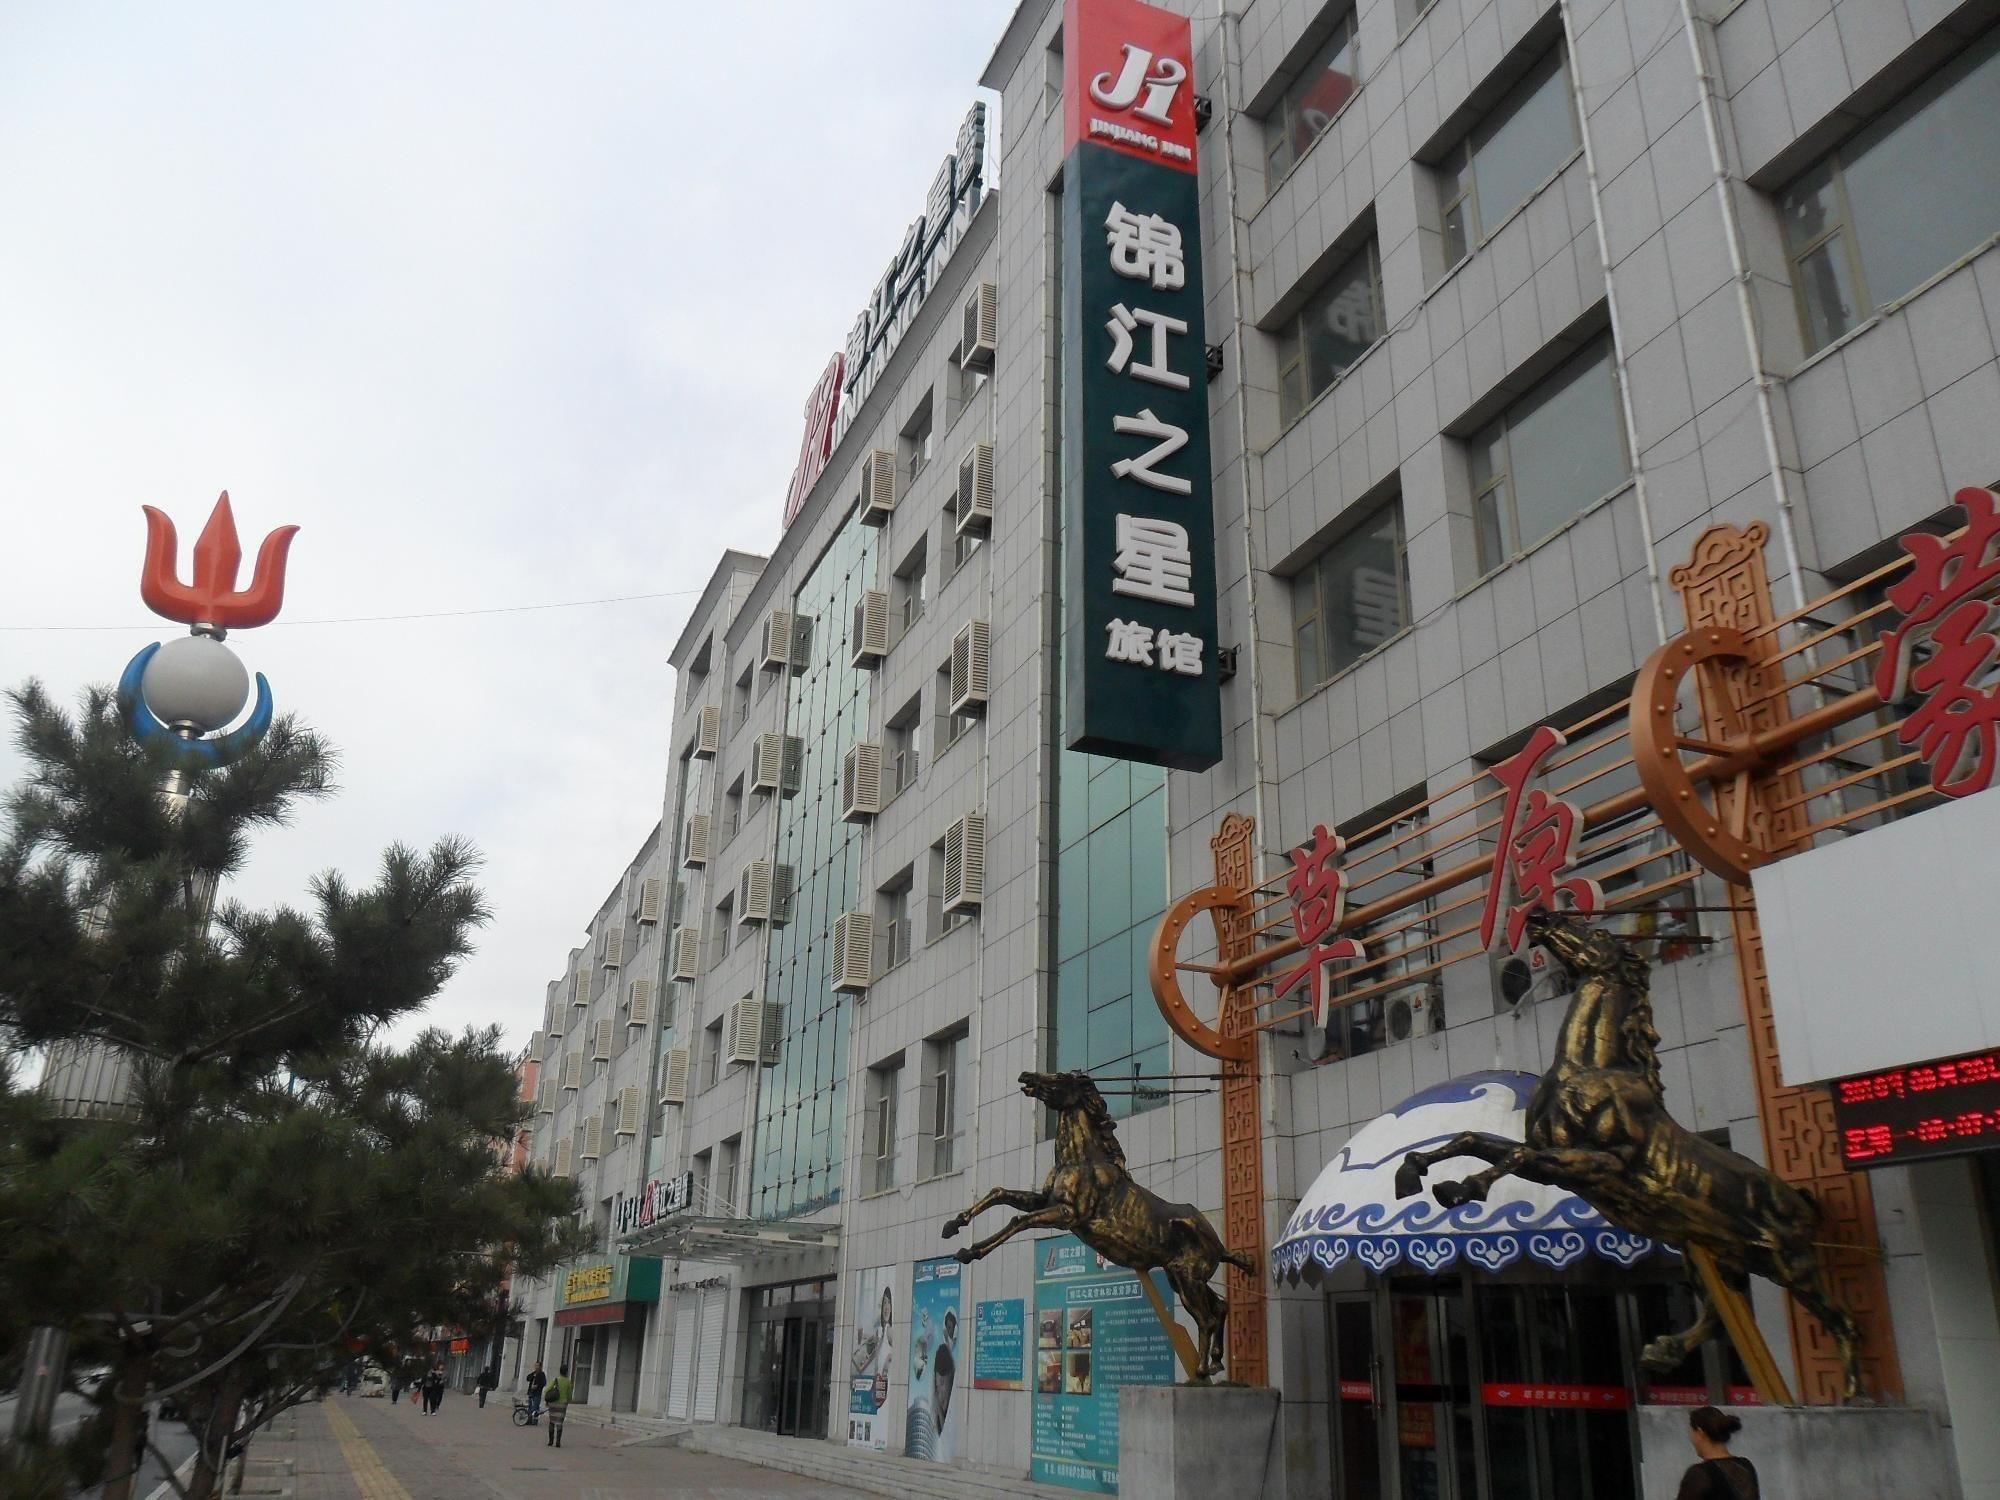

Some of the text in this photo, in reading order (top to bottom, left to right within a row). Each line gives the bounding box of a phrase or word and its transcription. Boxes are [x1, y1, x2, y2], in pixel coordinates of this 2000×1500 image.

[1104, 200, 1196, 609] 锦江之星
[1105, 617, 1204, 677] 旅馆
